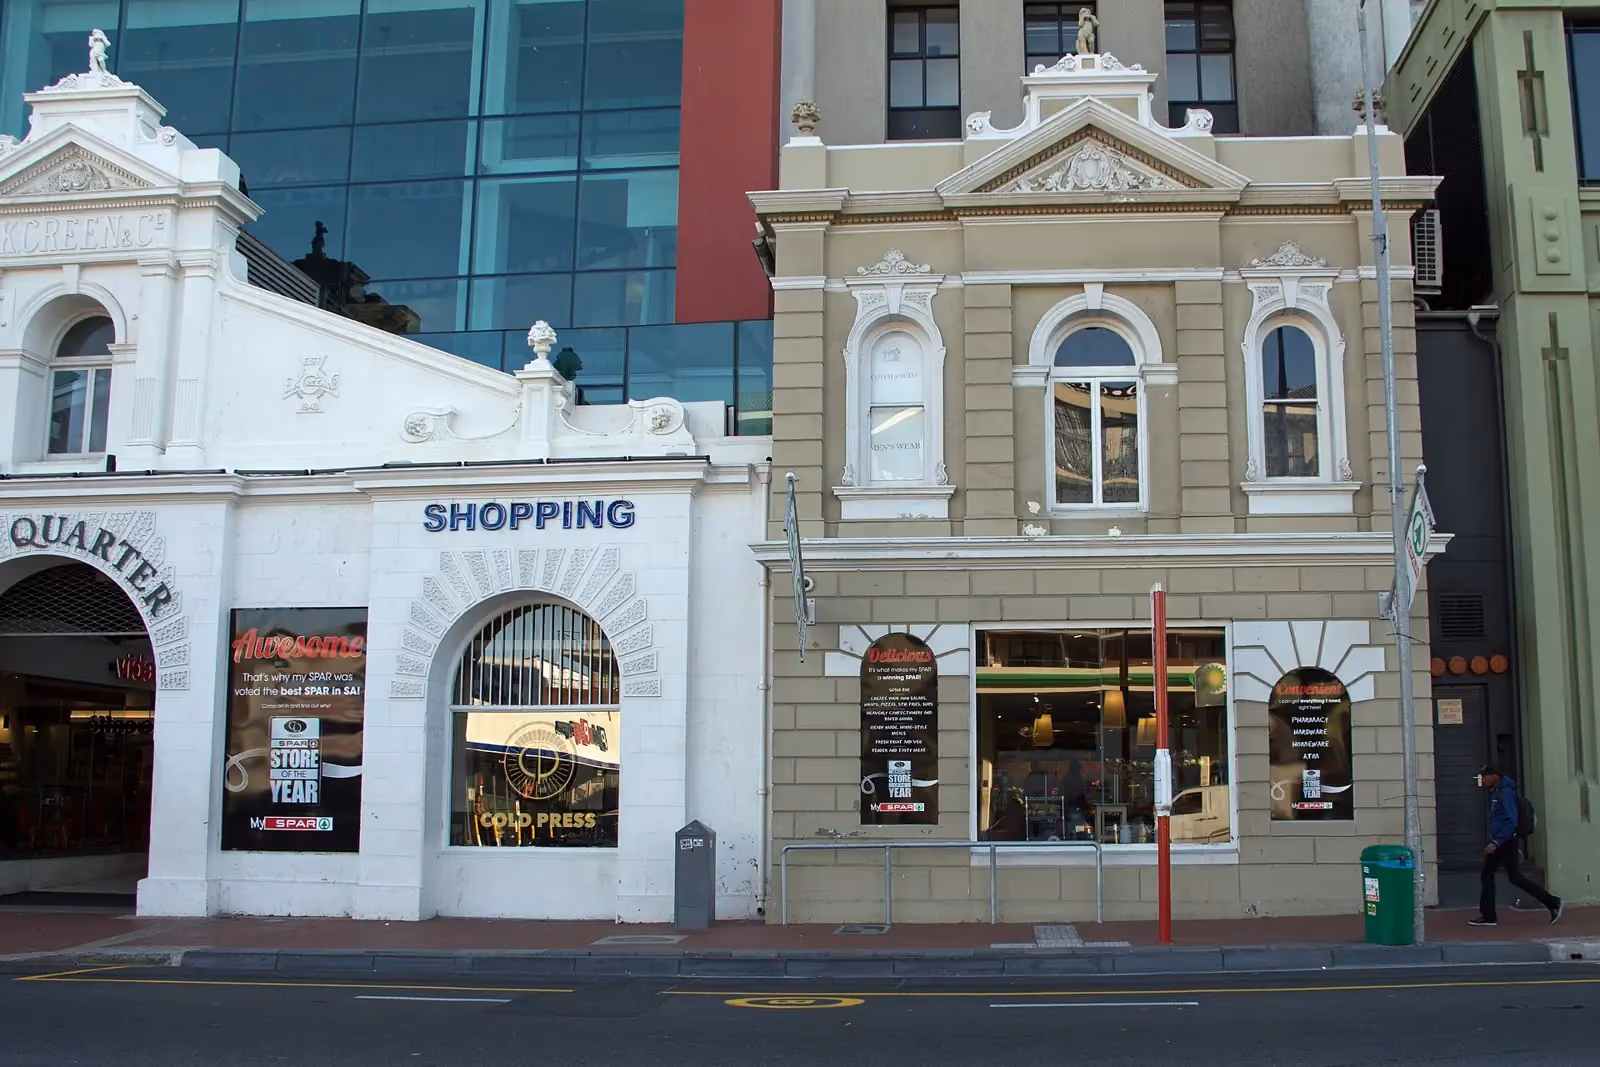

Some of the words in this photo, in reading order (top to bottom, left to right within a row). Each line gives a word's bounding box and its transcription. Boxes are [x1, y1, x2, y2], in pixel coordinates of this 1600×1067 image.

[896, 442, 921, 450] WEAR
[423, 499, 635, 532] SHOPPING
[10, 514, 173, 617] QUARTER
[232, 628, 364, 664] Awesome
[868, 648, 932, 664] Delicious
[243, 672, 269, 681] That's
[272, 673, 289, 683] why
[293, 674, 307, 683] my
[309, 672, 331, 681] SPAR
[234, 687, 260, 696] voted
[263, 686, 278, 695] the
[280, 686, 302, 695] best
[304, 687, 329, 695] SPAR
[332, 687, 341, 695] in
[343, 686, 360, 695] SA!
[1277, 683, 1344, 696] Convenient
[270, 749, 319, 768] STORE
[888, 774, 911, 783] STORE
[270, 780, 318, 803] YEAR
[889, 788, 912, 798] YEAR
[1303, 790, 1320, 798] YEAR
[871, 803, 880, 812] My
[250, 817, 265, 830] My
[276, 820, 316, 828] SPAR
[480, 812, 532, 828] COLD
[537, 812, 596, 828] PRESS
